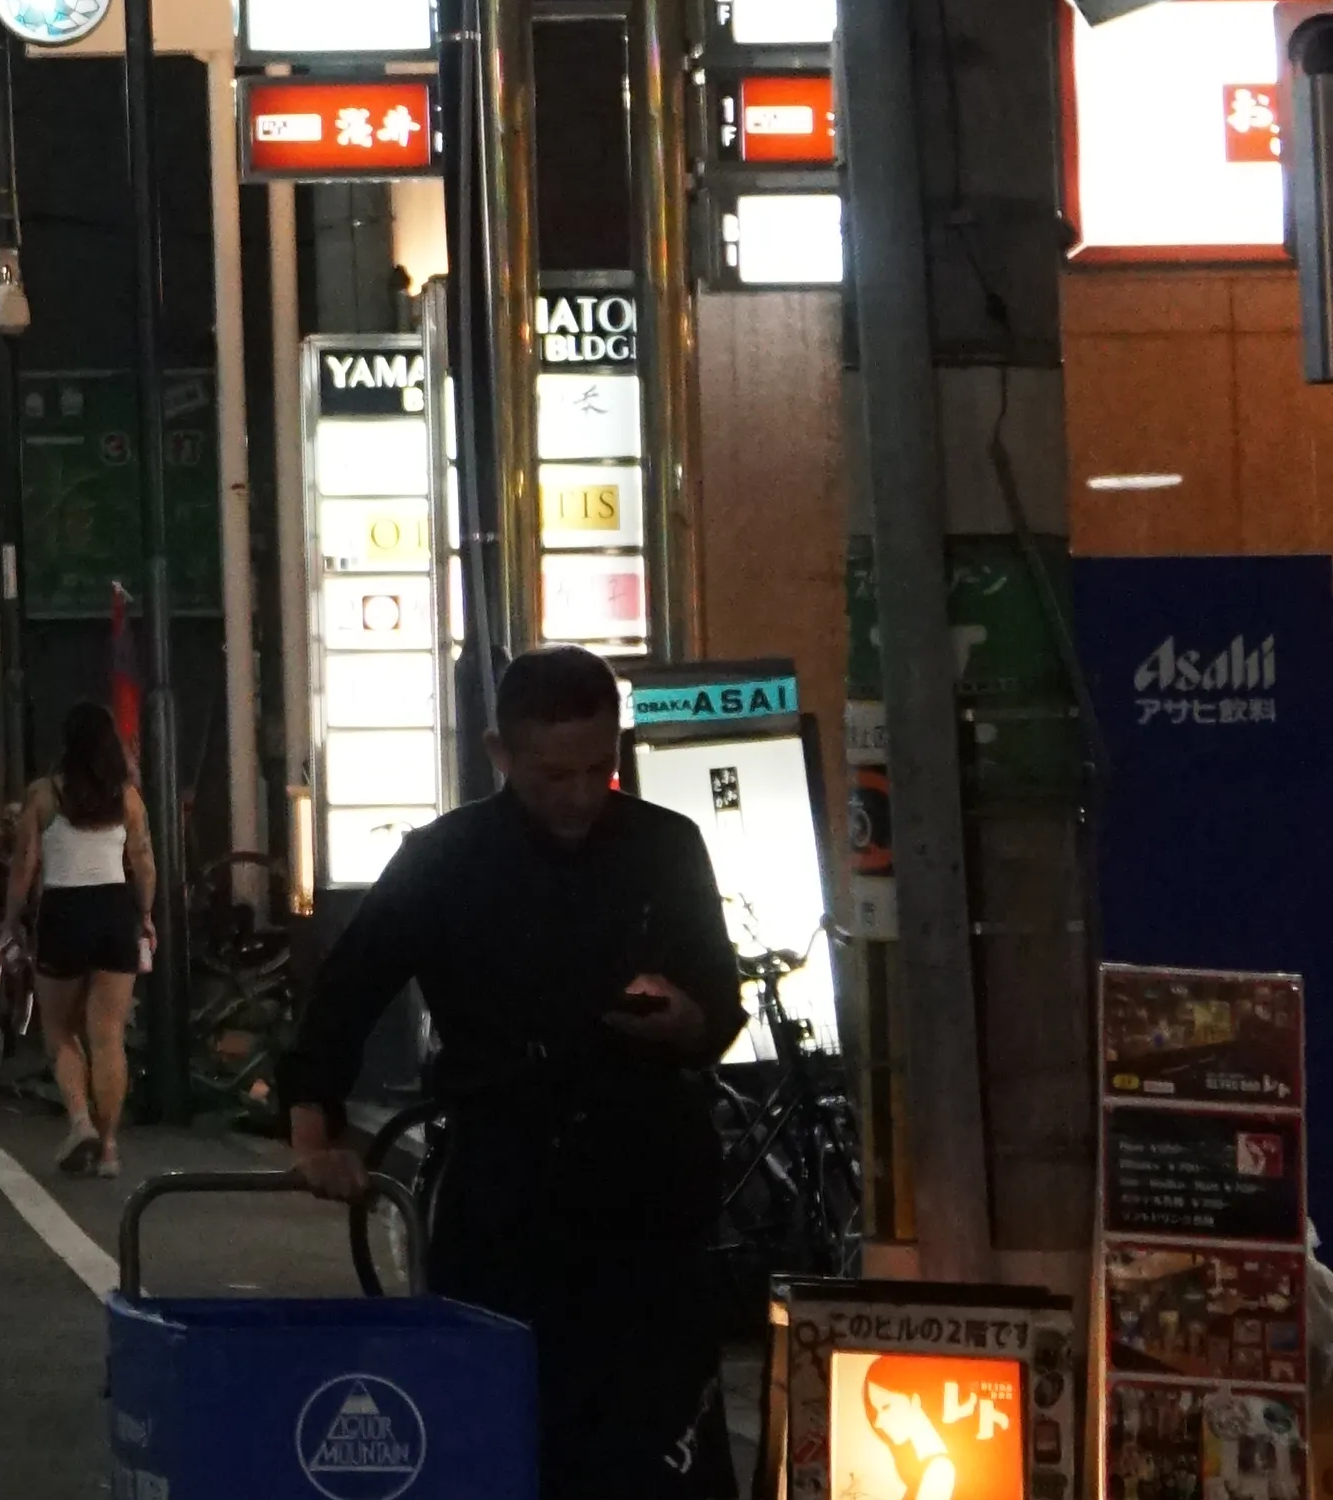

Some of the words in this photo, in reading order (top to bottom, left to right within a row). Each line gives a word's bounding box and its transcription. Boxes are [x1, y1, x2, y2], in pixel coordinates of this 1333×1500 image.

[1135, 633, 1276, 694] Asahi
[636, 699, 692, 714] OSAKA
[693, 686, 787, 716] ASAI
[1135, 698, 1277, 723] アサヒ飲料
[320, 1441, 411, 1467] MOUNTAIN
